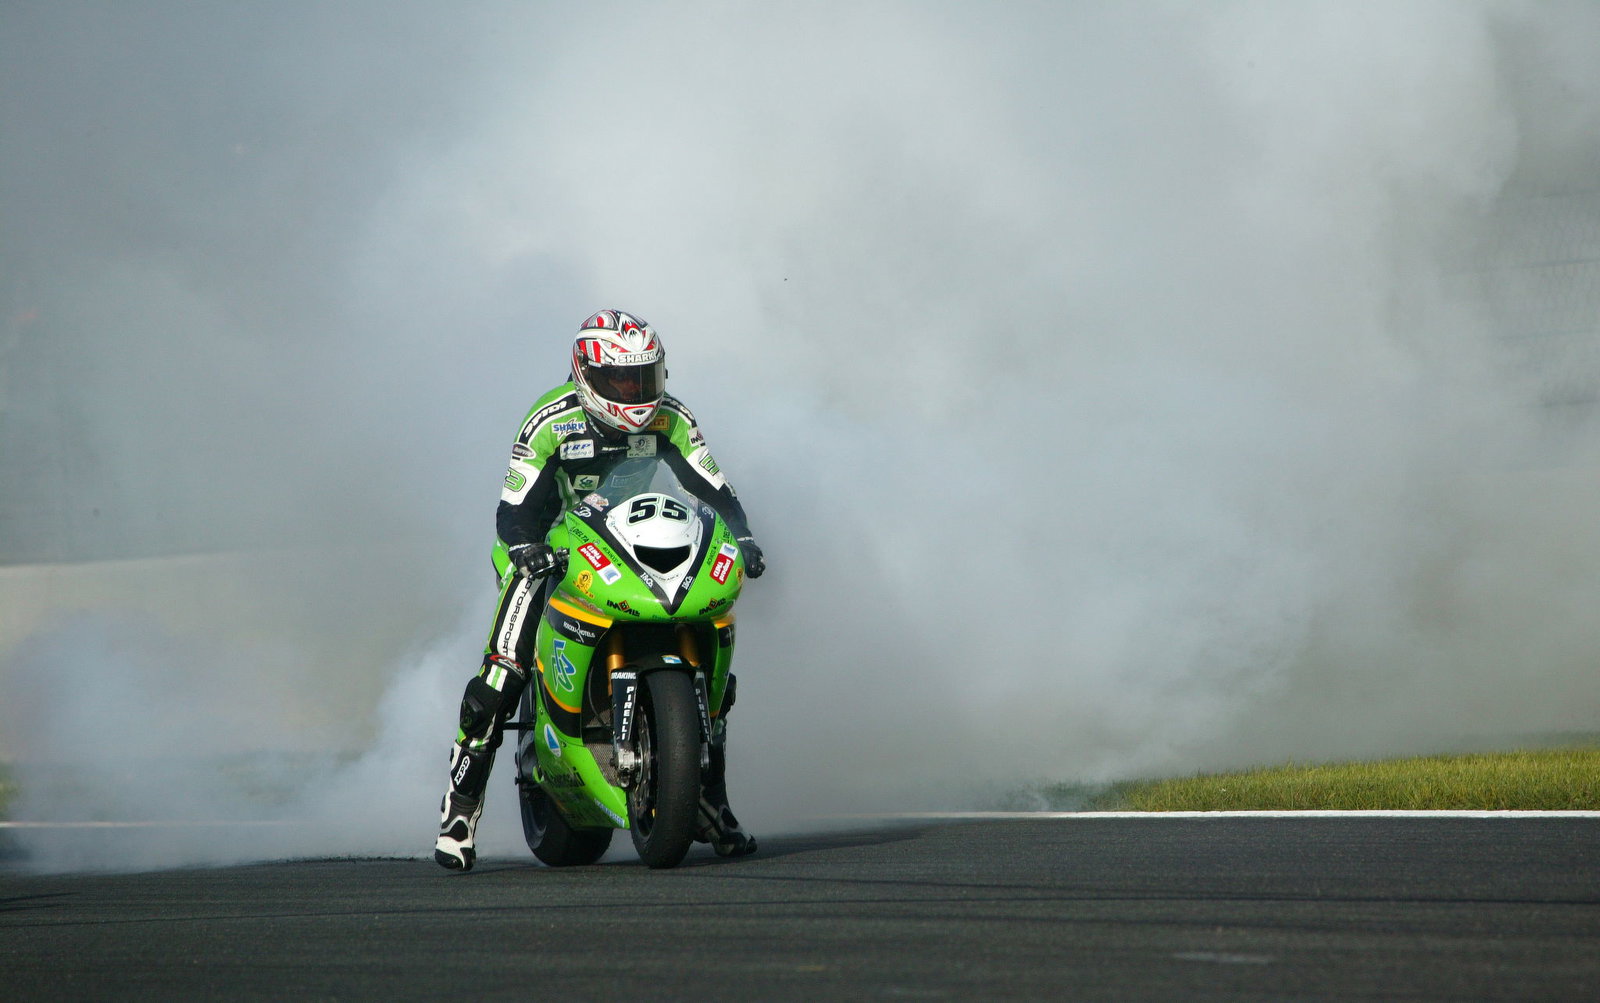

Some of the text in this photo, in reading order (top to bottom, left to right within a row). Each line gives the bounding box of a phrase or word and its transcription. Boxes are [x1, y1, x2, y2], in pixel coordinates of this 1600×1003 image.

[618, 352, 656, 364] SHARK
[553, 422, 585, 432] SHARK
[629, 497, 688, 524] 55
[621, 686, 635, 741] PIRELLI
[695, 688, 710, 742] PIRELLI
